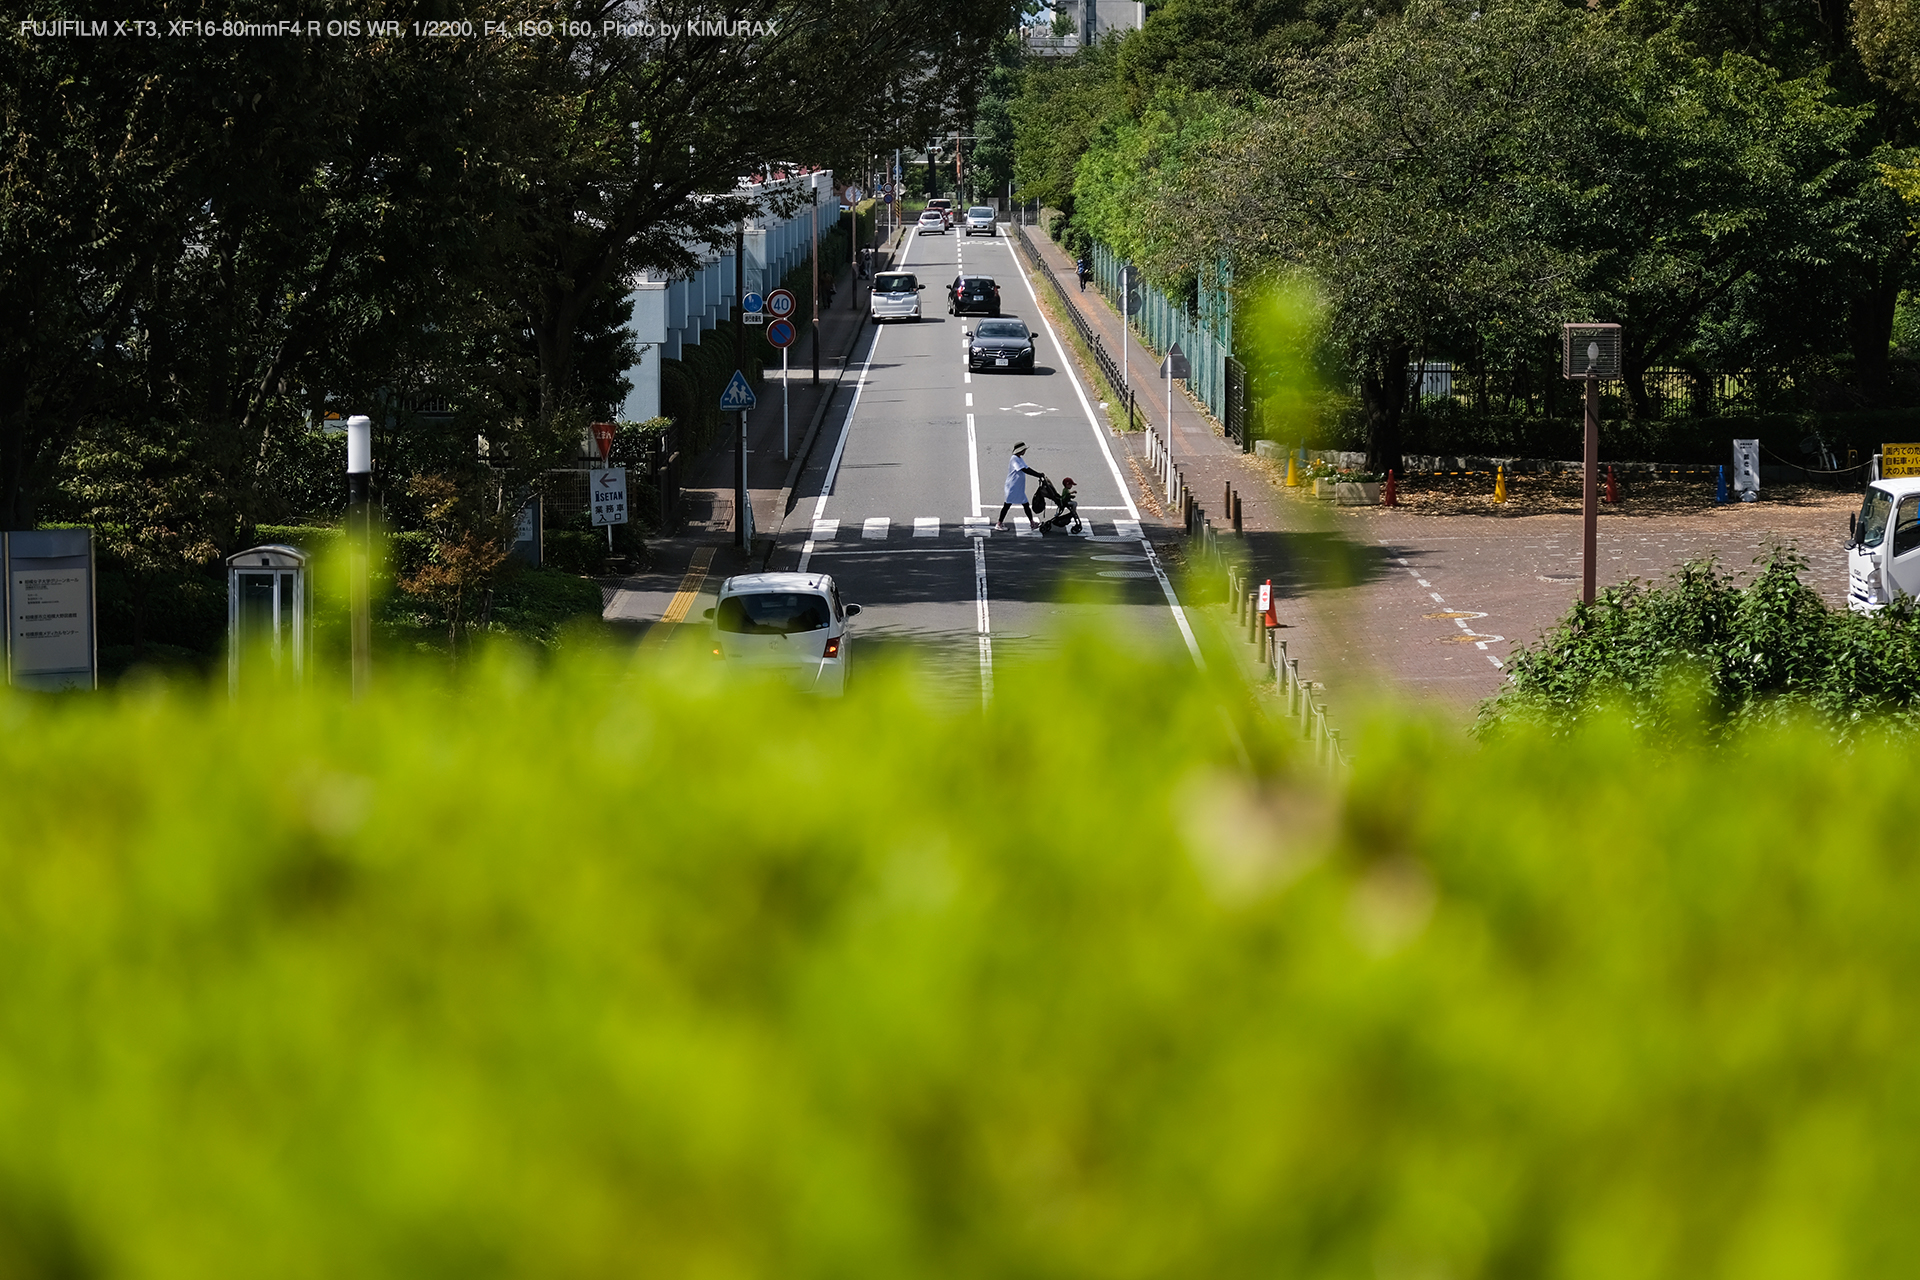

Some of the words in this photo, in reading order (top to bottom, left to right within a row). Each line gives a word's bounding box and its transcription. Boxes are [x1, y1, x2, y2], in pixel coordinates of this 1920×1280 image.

[773, 297, 789, 311] 40
[594, 490, 623, 502] ISETAN
[595, 503, 624, 515] 業務車
[598, 513, 622, 523] 入口
